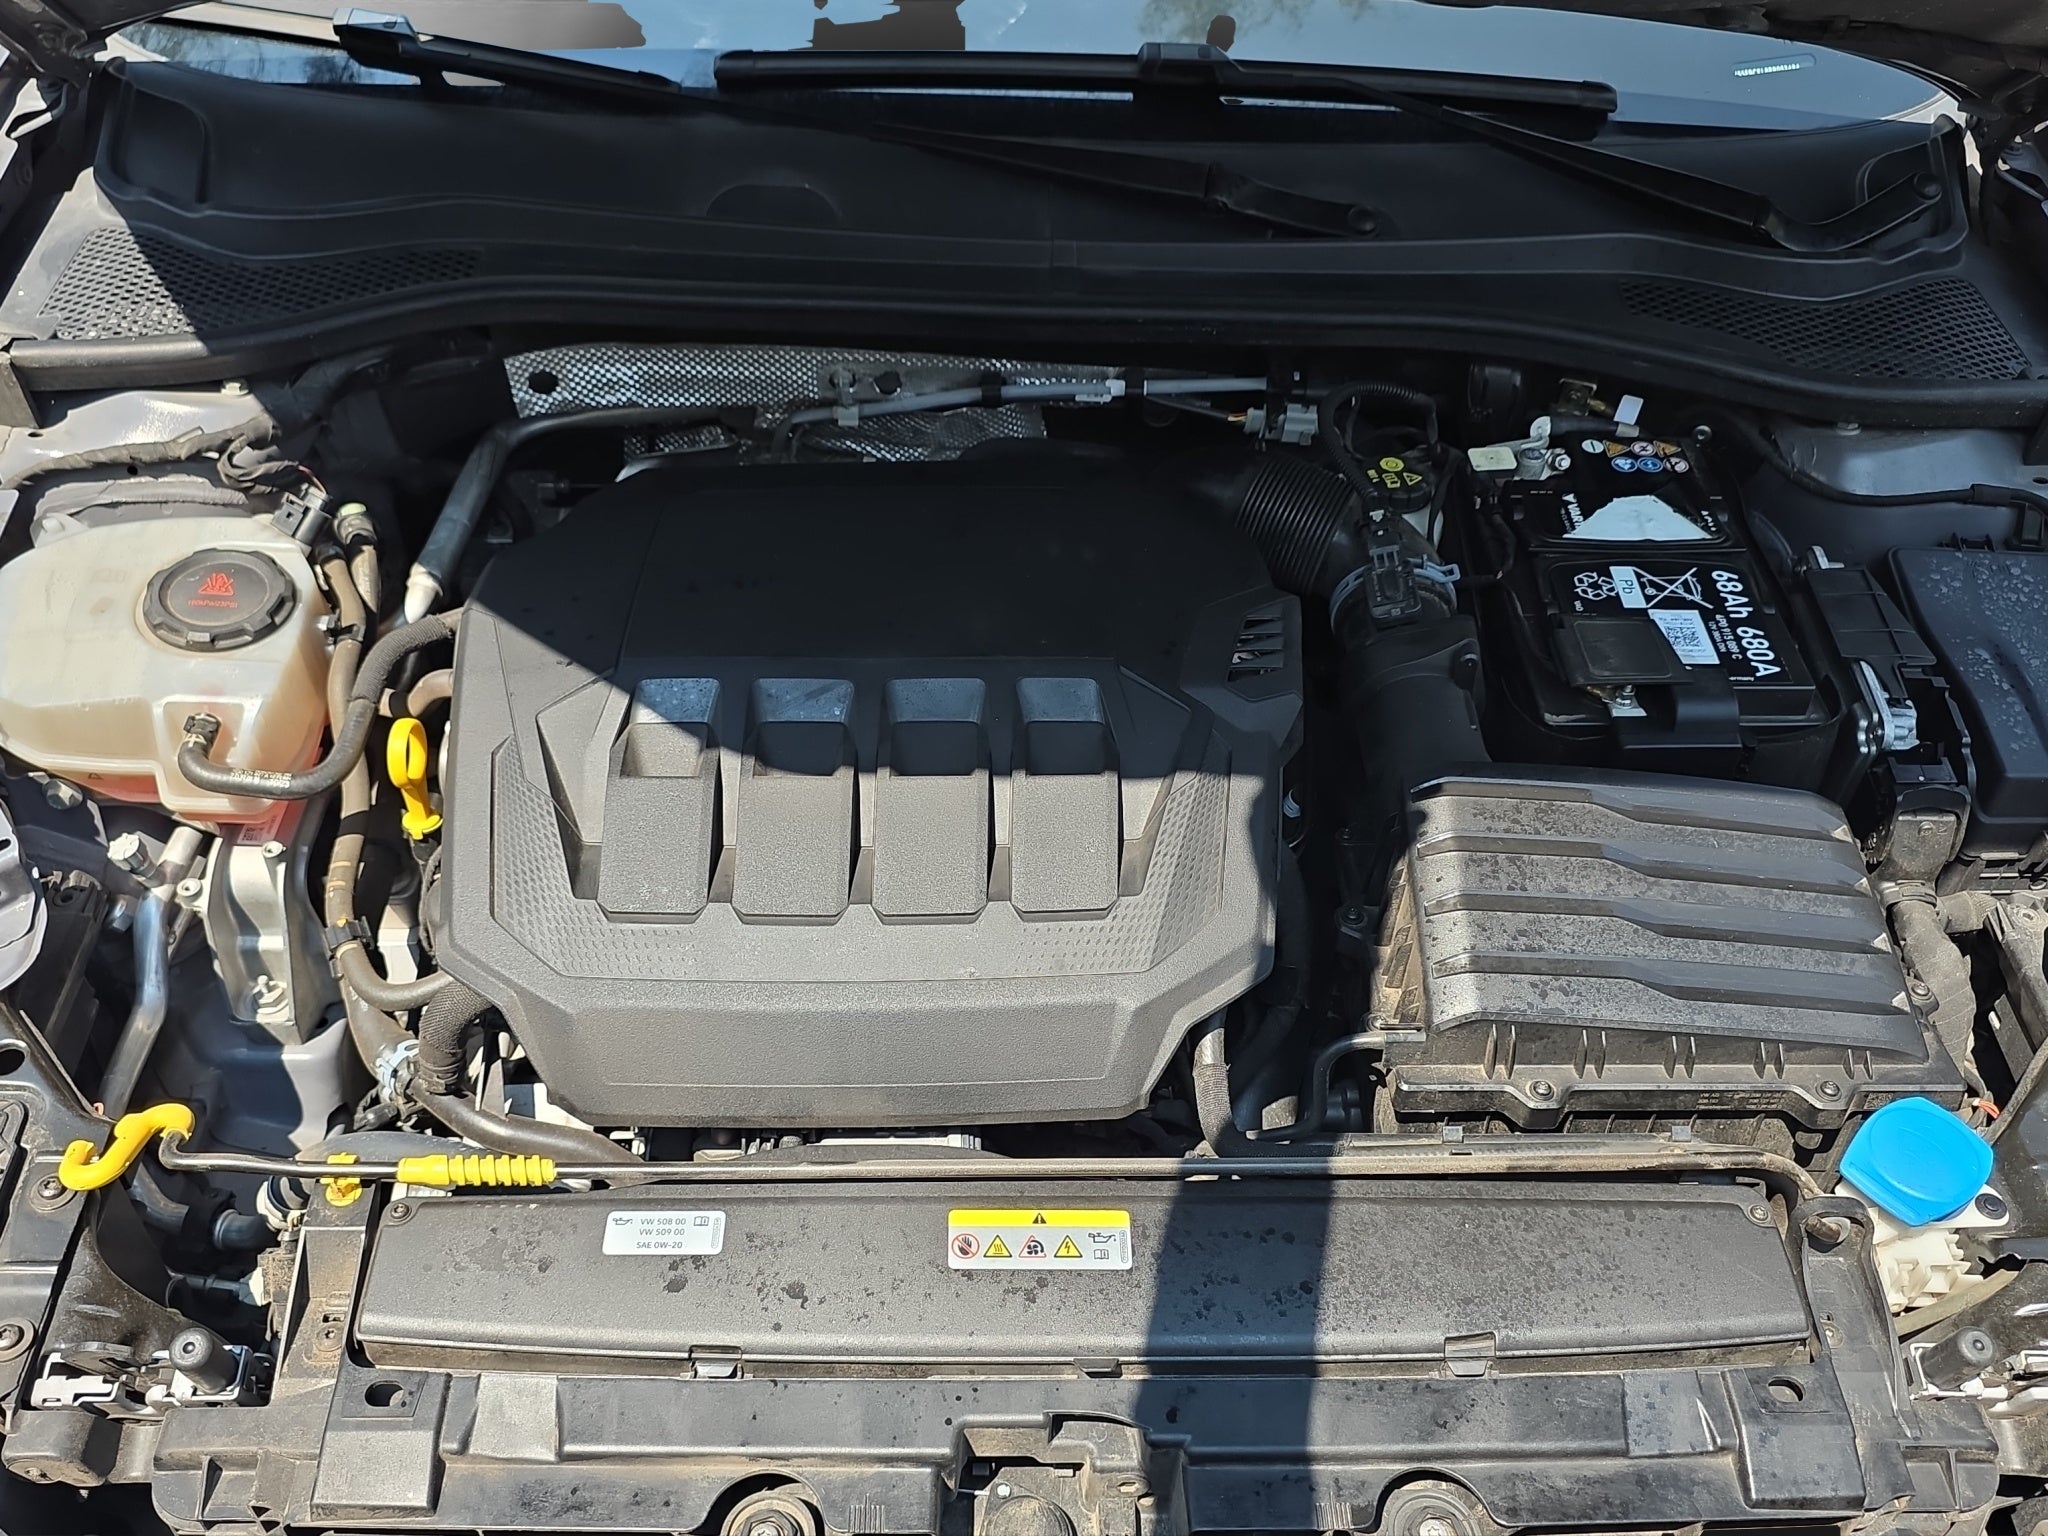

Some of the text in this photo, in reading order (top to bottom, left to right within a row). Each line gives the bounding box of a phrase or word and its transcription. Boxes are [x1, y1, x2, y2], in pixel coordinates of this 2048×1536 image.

[1619, 579, 1635, 595] Pb
[1711, 570, 1782, 677] 68Ah 680A
[1720, 628, 1734, 640] 915
[639, 1228, 685, 1236] VW 509 00
[636, 1241, 683, 1249] SAE 0W-20
